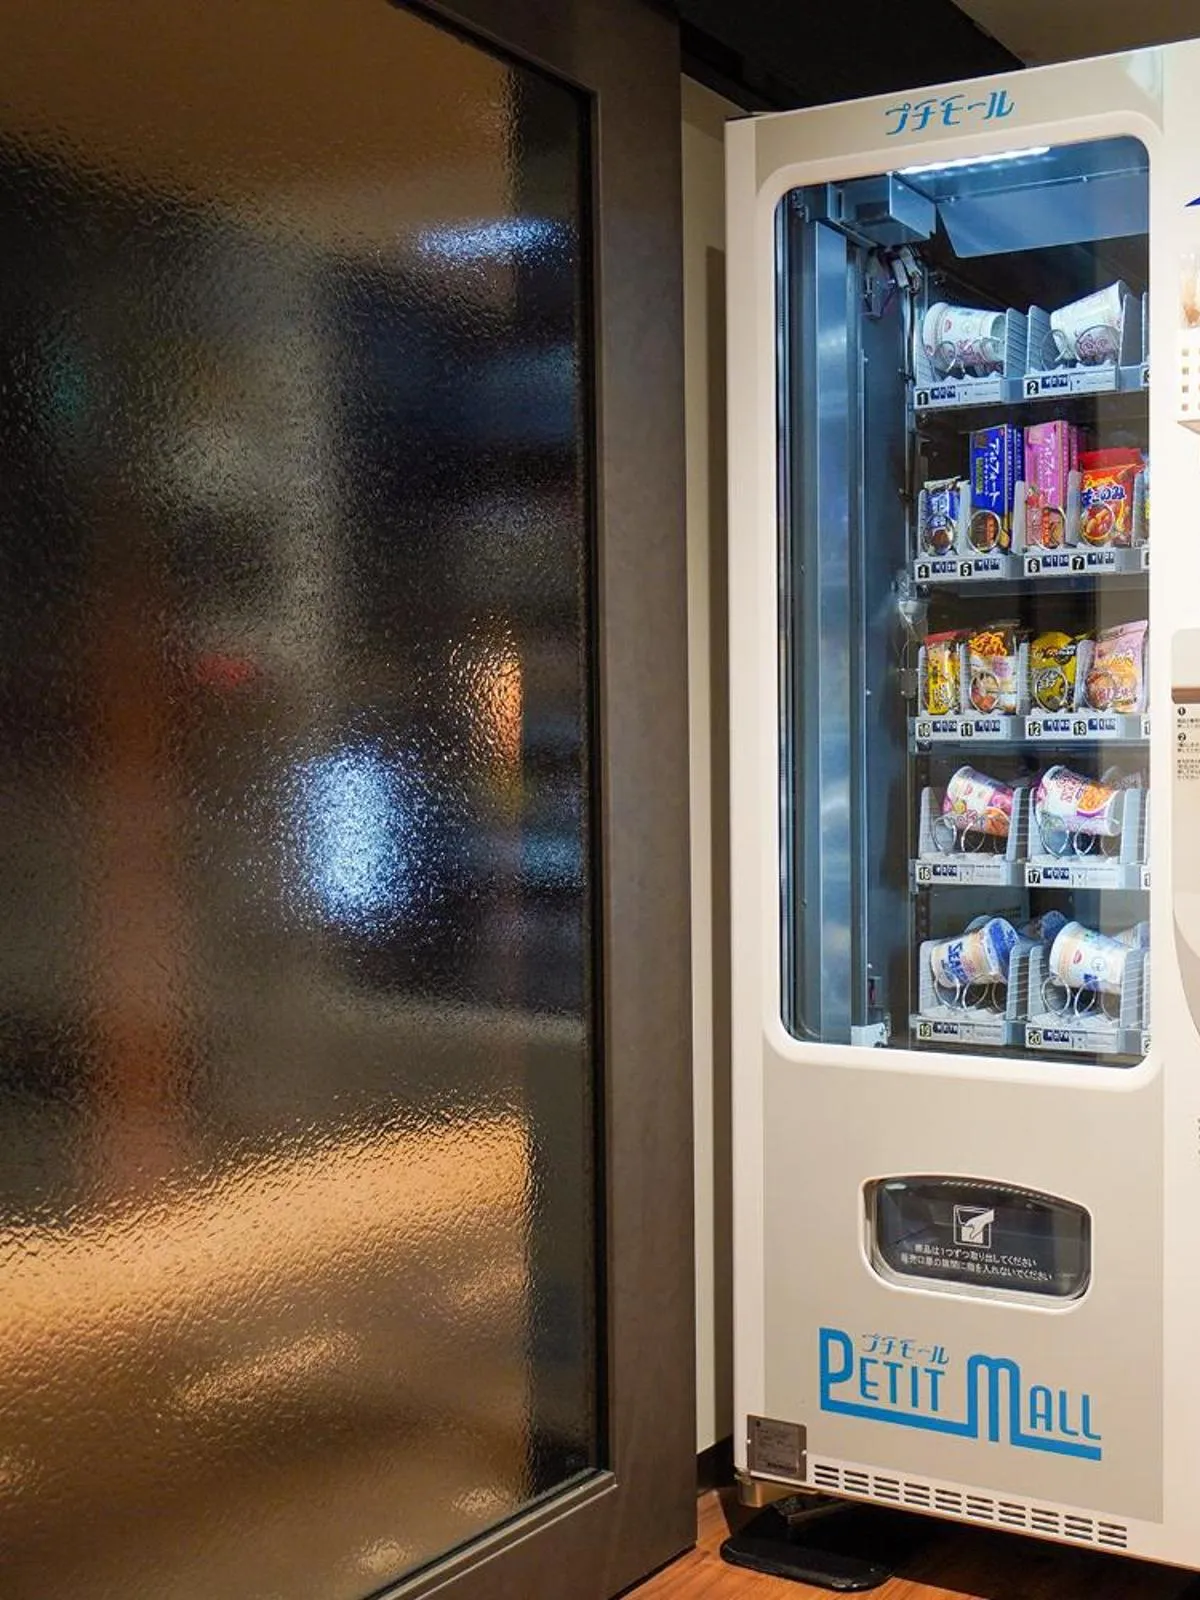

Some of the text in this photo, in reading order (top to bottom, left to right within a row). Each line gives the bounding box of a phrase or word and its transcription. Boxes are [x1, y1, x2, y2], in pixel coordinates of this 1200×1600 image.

[885, 90, 1015, 136] プチモール
[989, 437, 1001, 507] アルフォート
[862, 1332, 950, 1366] プチモール
[819, 1327, 1102, 1462] PETIT MALL
